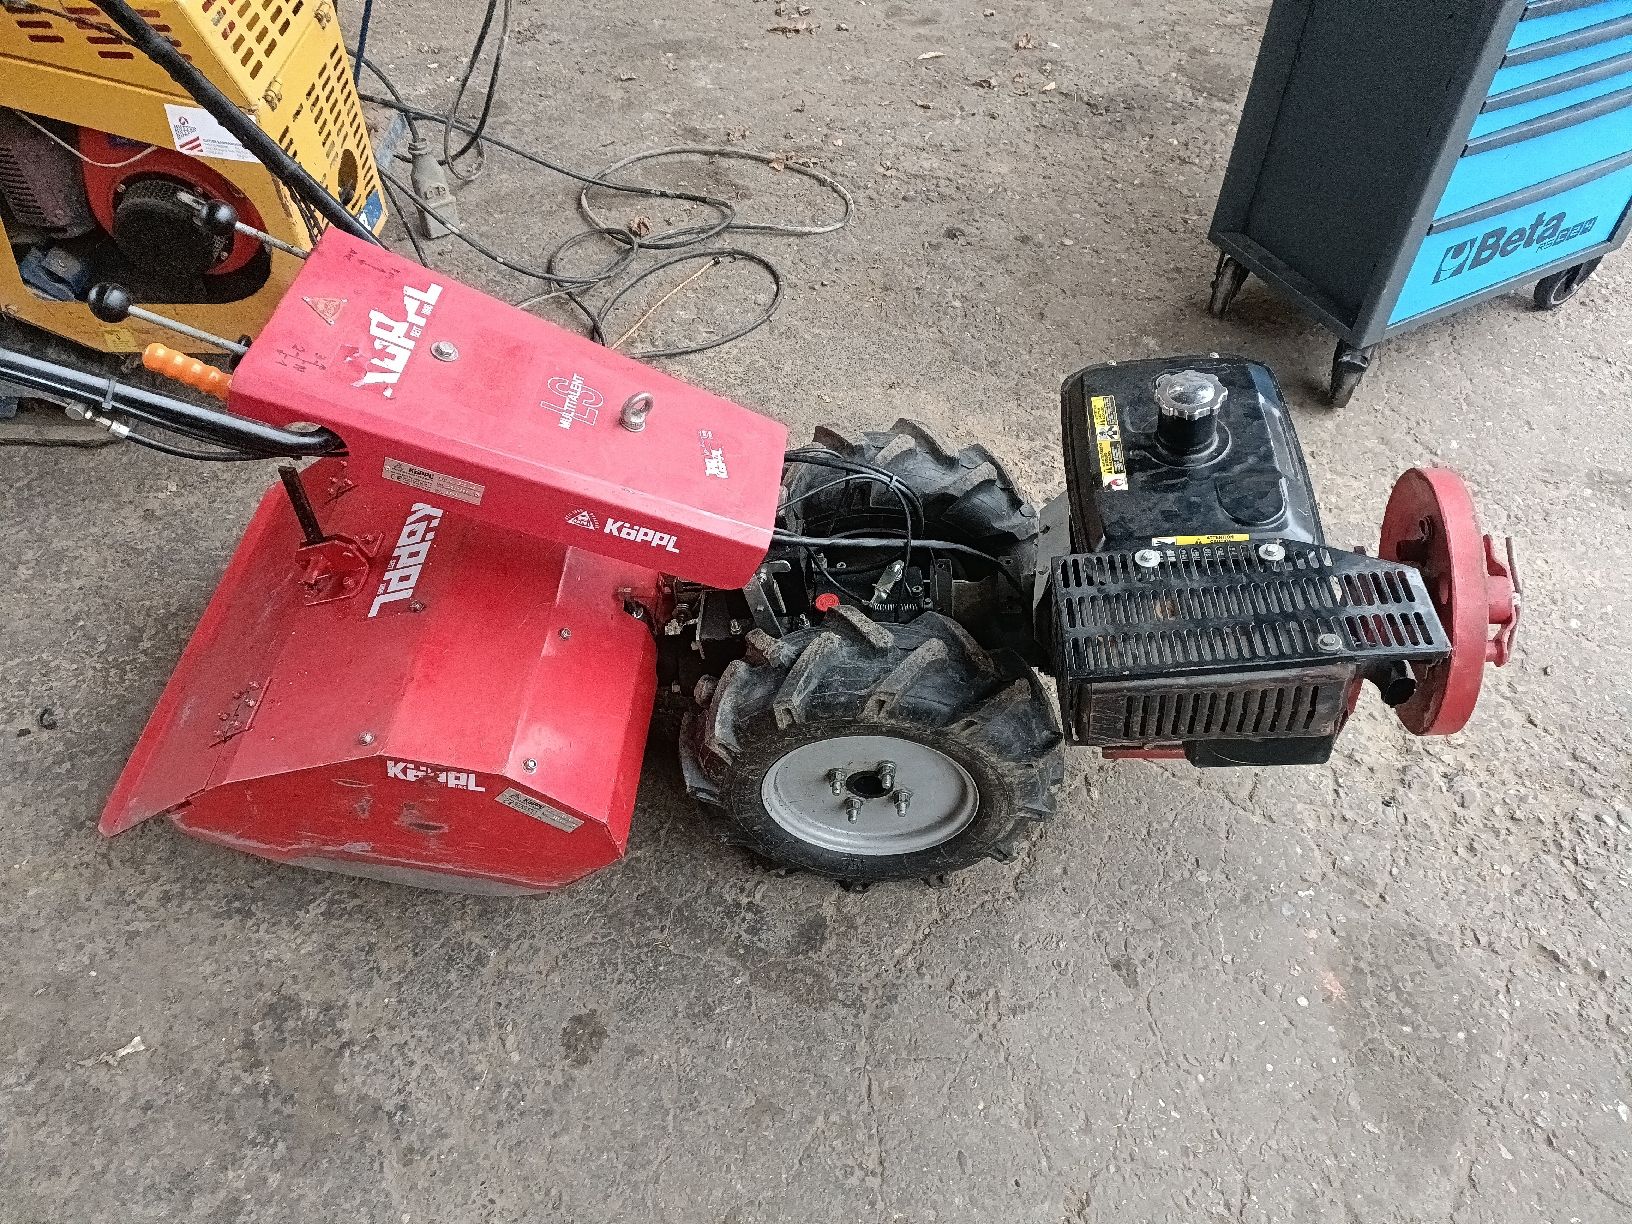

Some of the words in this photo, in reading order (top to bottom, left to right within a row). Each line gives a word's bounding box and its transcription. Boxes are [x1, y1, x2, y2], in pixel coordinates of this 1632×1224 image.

[1467, 212, 1566, 271] Beta
[540, 377, 603, 425] LS
[558, 373, 584, 429] MULTITALENT
[603, 518, 680, 553] KöPPL
